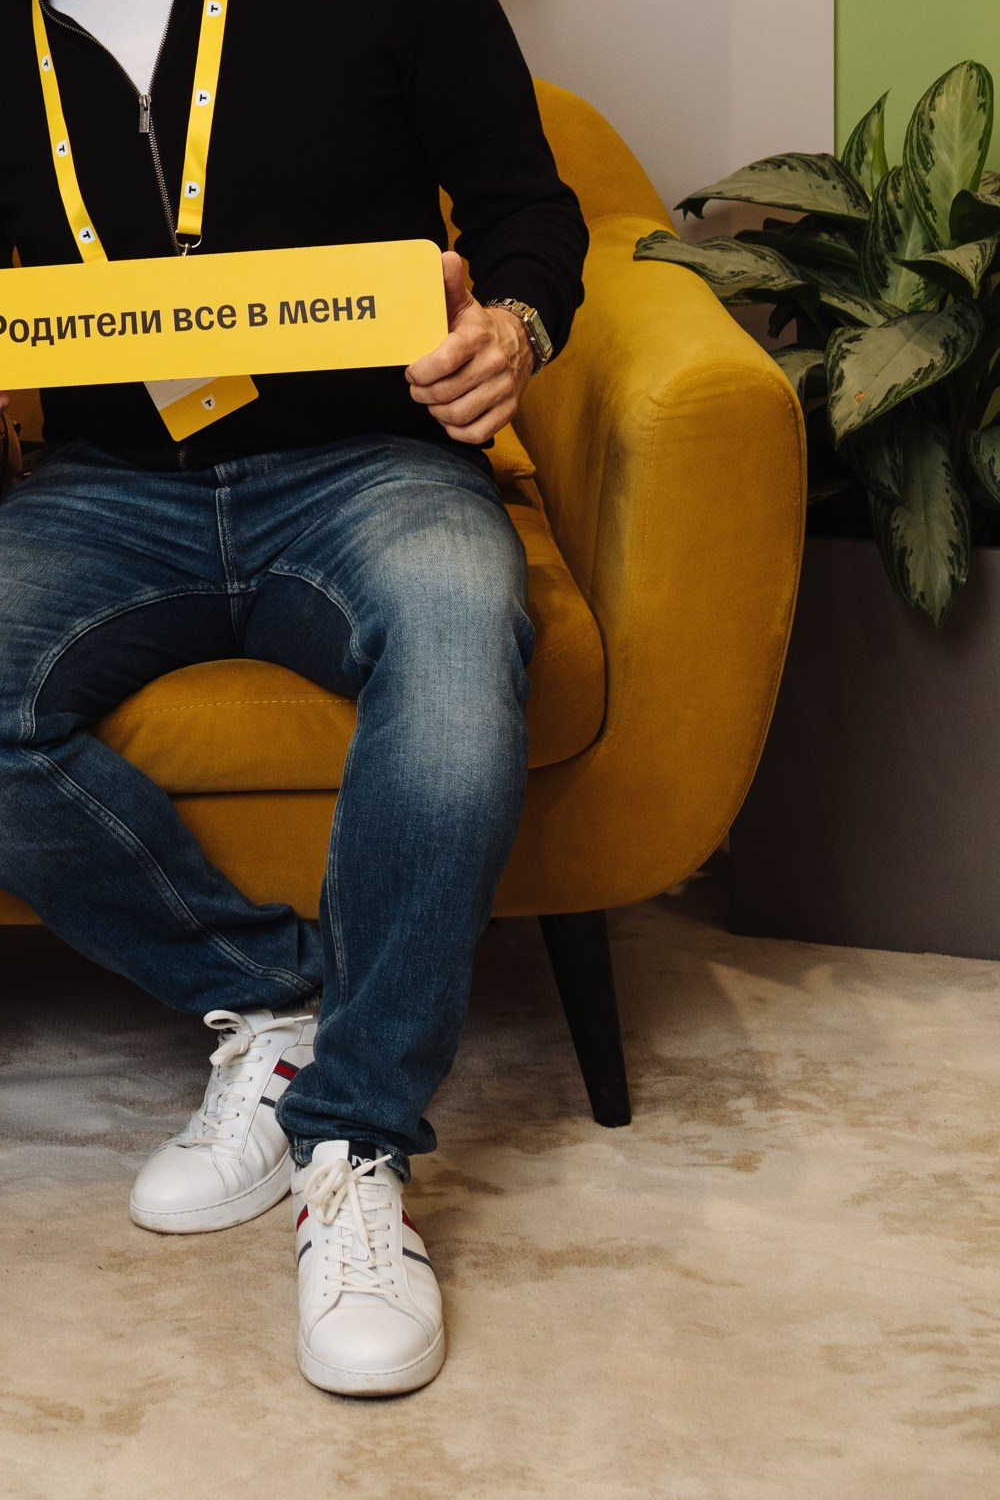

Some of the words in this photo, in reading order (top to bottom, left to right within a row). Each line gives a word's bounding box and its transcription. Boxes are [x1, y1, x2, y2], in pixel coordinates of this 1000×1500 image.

[173, 304, 237, 332] все
[247, 302, 268, 327] в
[279, 295, 376, 325] меня
